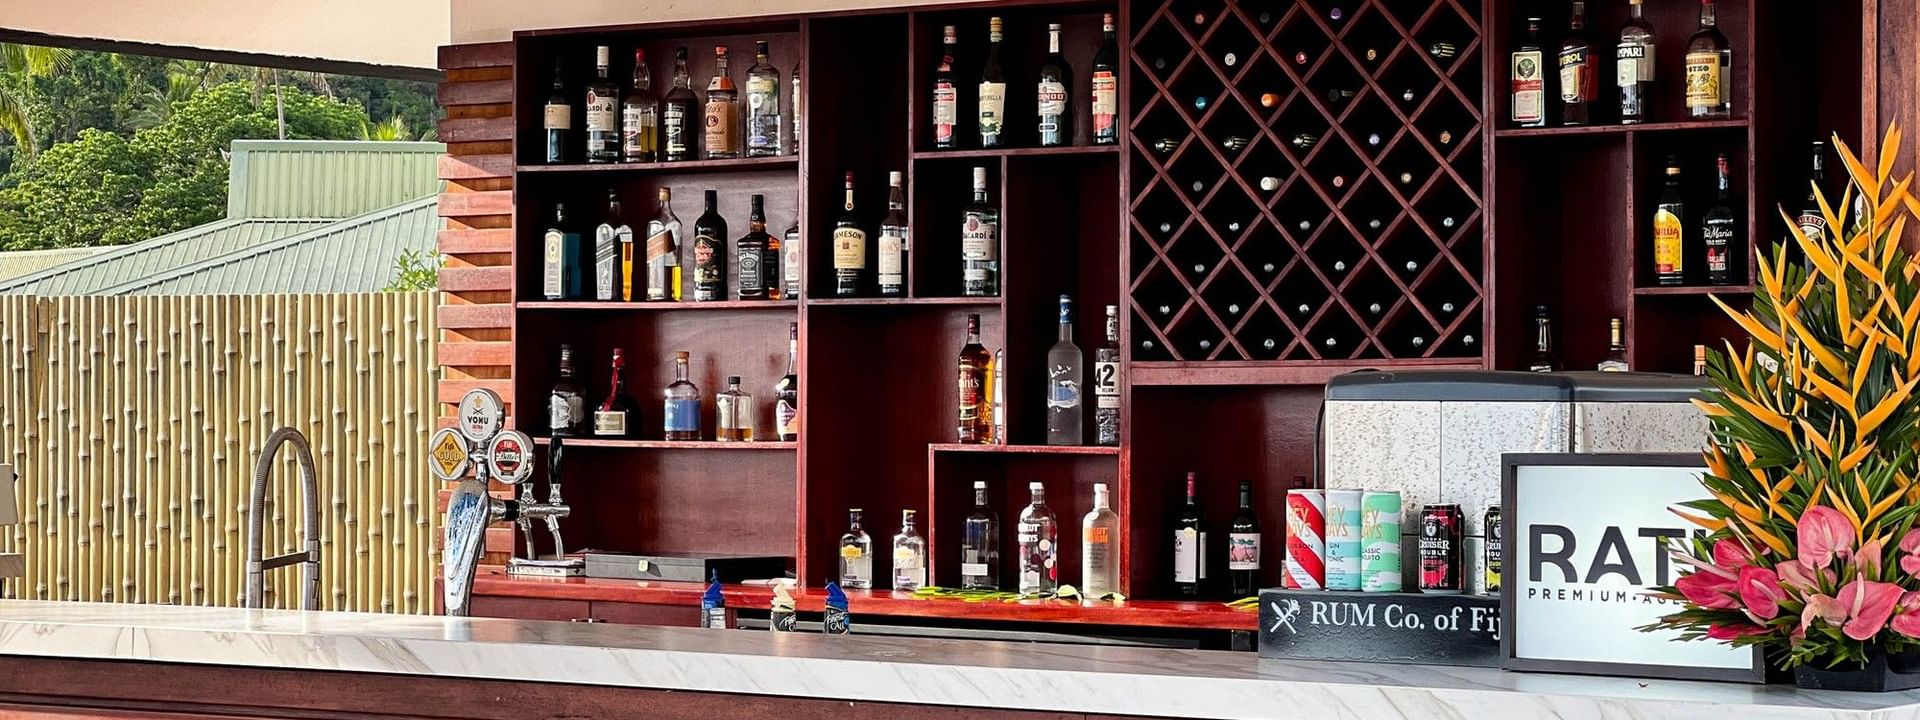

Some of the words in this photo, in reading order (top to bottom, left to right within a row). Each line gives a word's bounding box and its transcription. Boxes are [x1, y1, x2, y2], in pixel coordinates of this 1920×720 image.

[1711, 226, 1733, 238] Maria
[1310, 600, 1377, 627] RUM
[1384, 603, 1425, 629] Co.
[1433, 607, 1463, 631] of
